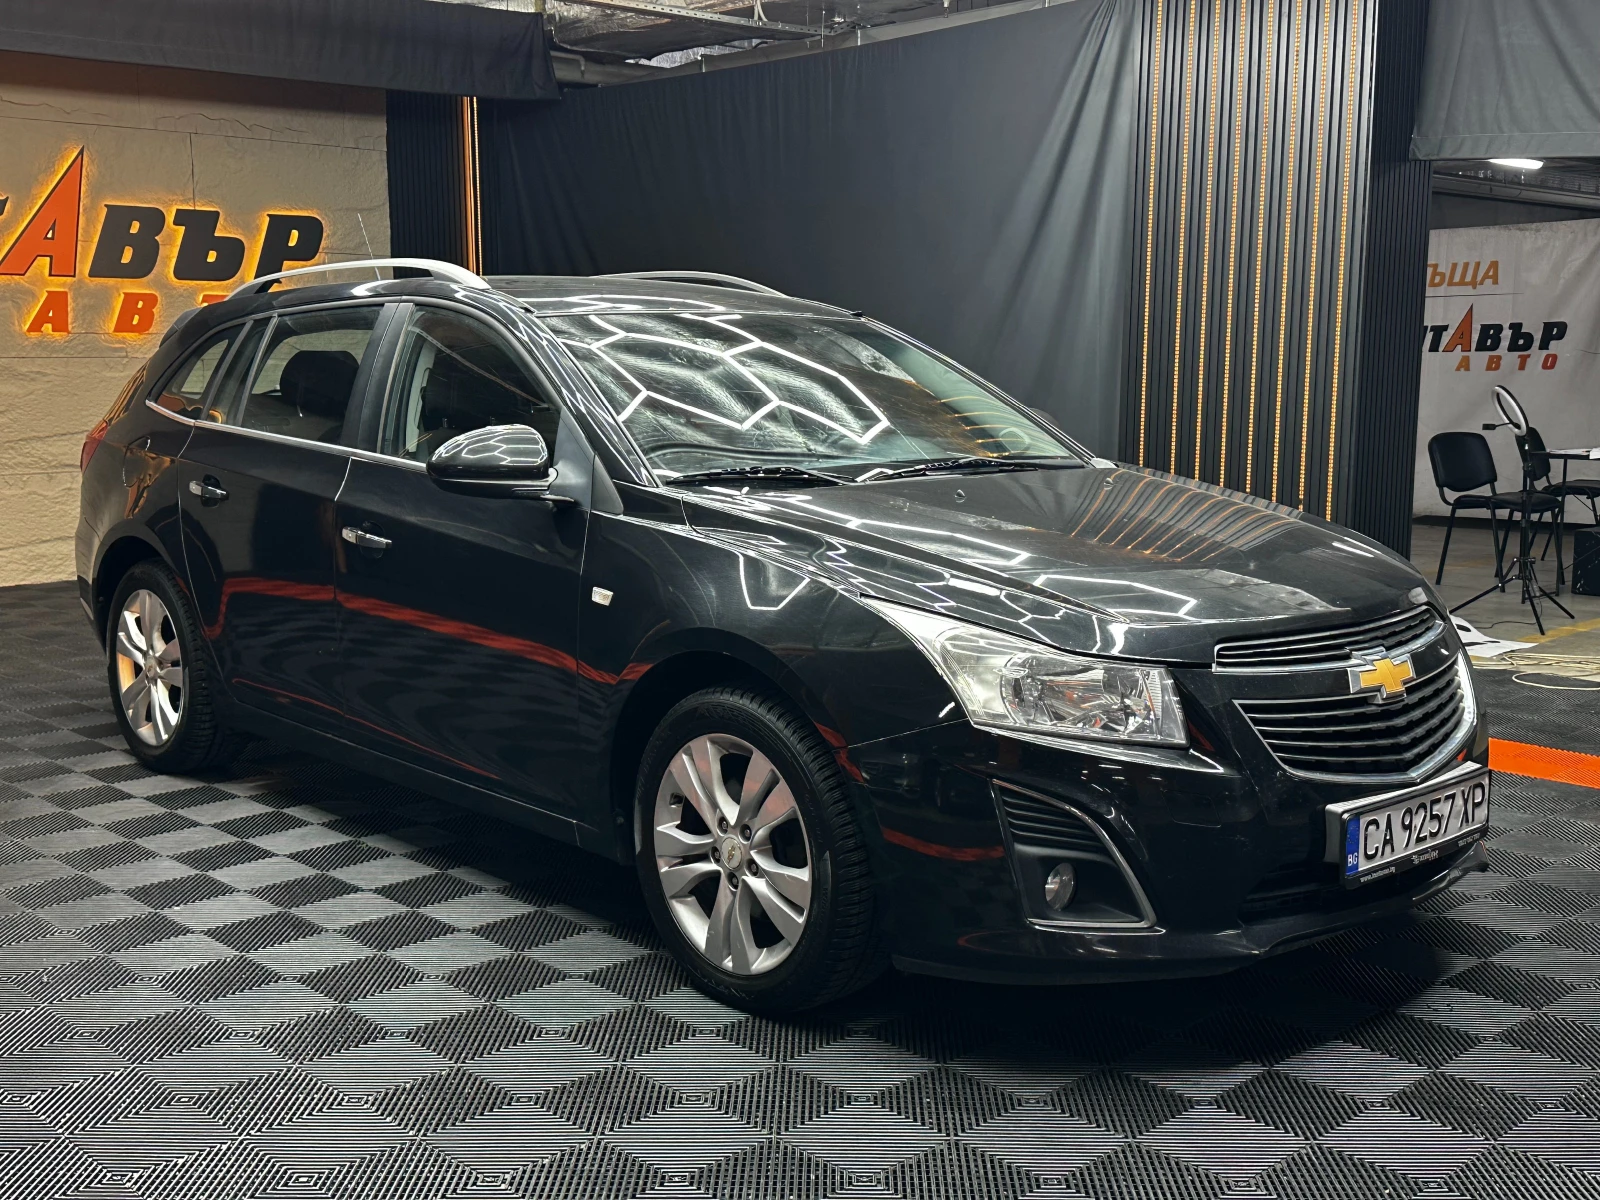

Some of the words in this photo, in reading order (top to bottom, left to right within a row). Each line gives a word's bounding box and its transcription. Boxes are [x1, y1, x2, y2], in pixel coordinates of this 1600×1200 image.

[0, 145, 324, 284] АВЪР
[1455, 354, 1558, 371] АВТО
[1363, 812, 1395, 860] CA
[1400, 791, 1456, 849] 9257
[1459, 781, 1486, 828] XP
[1347, 852, 1358, 866] BG
